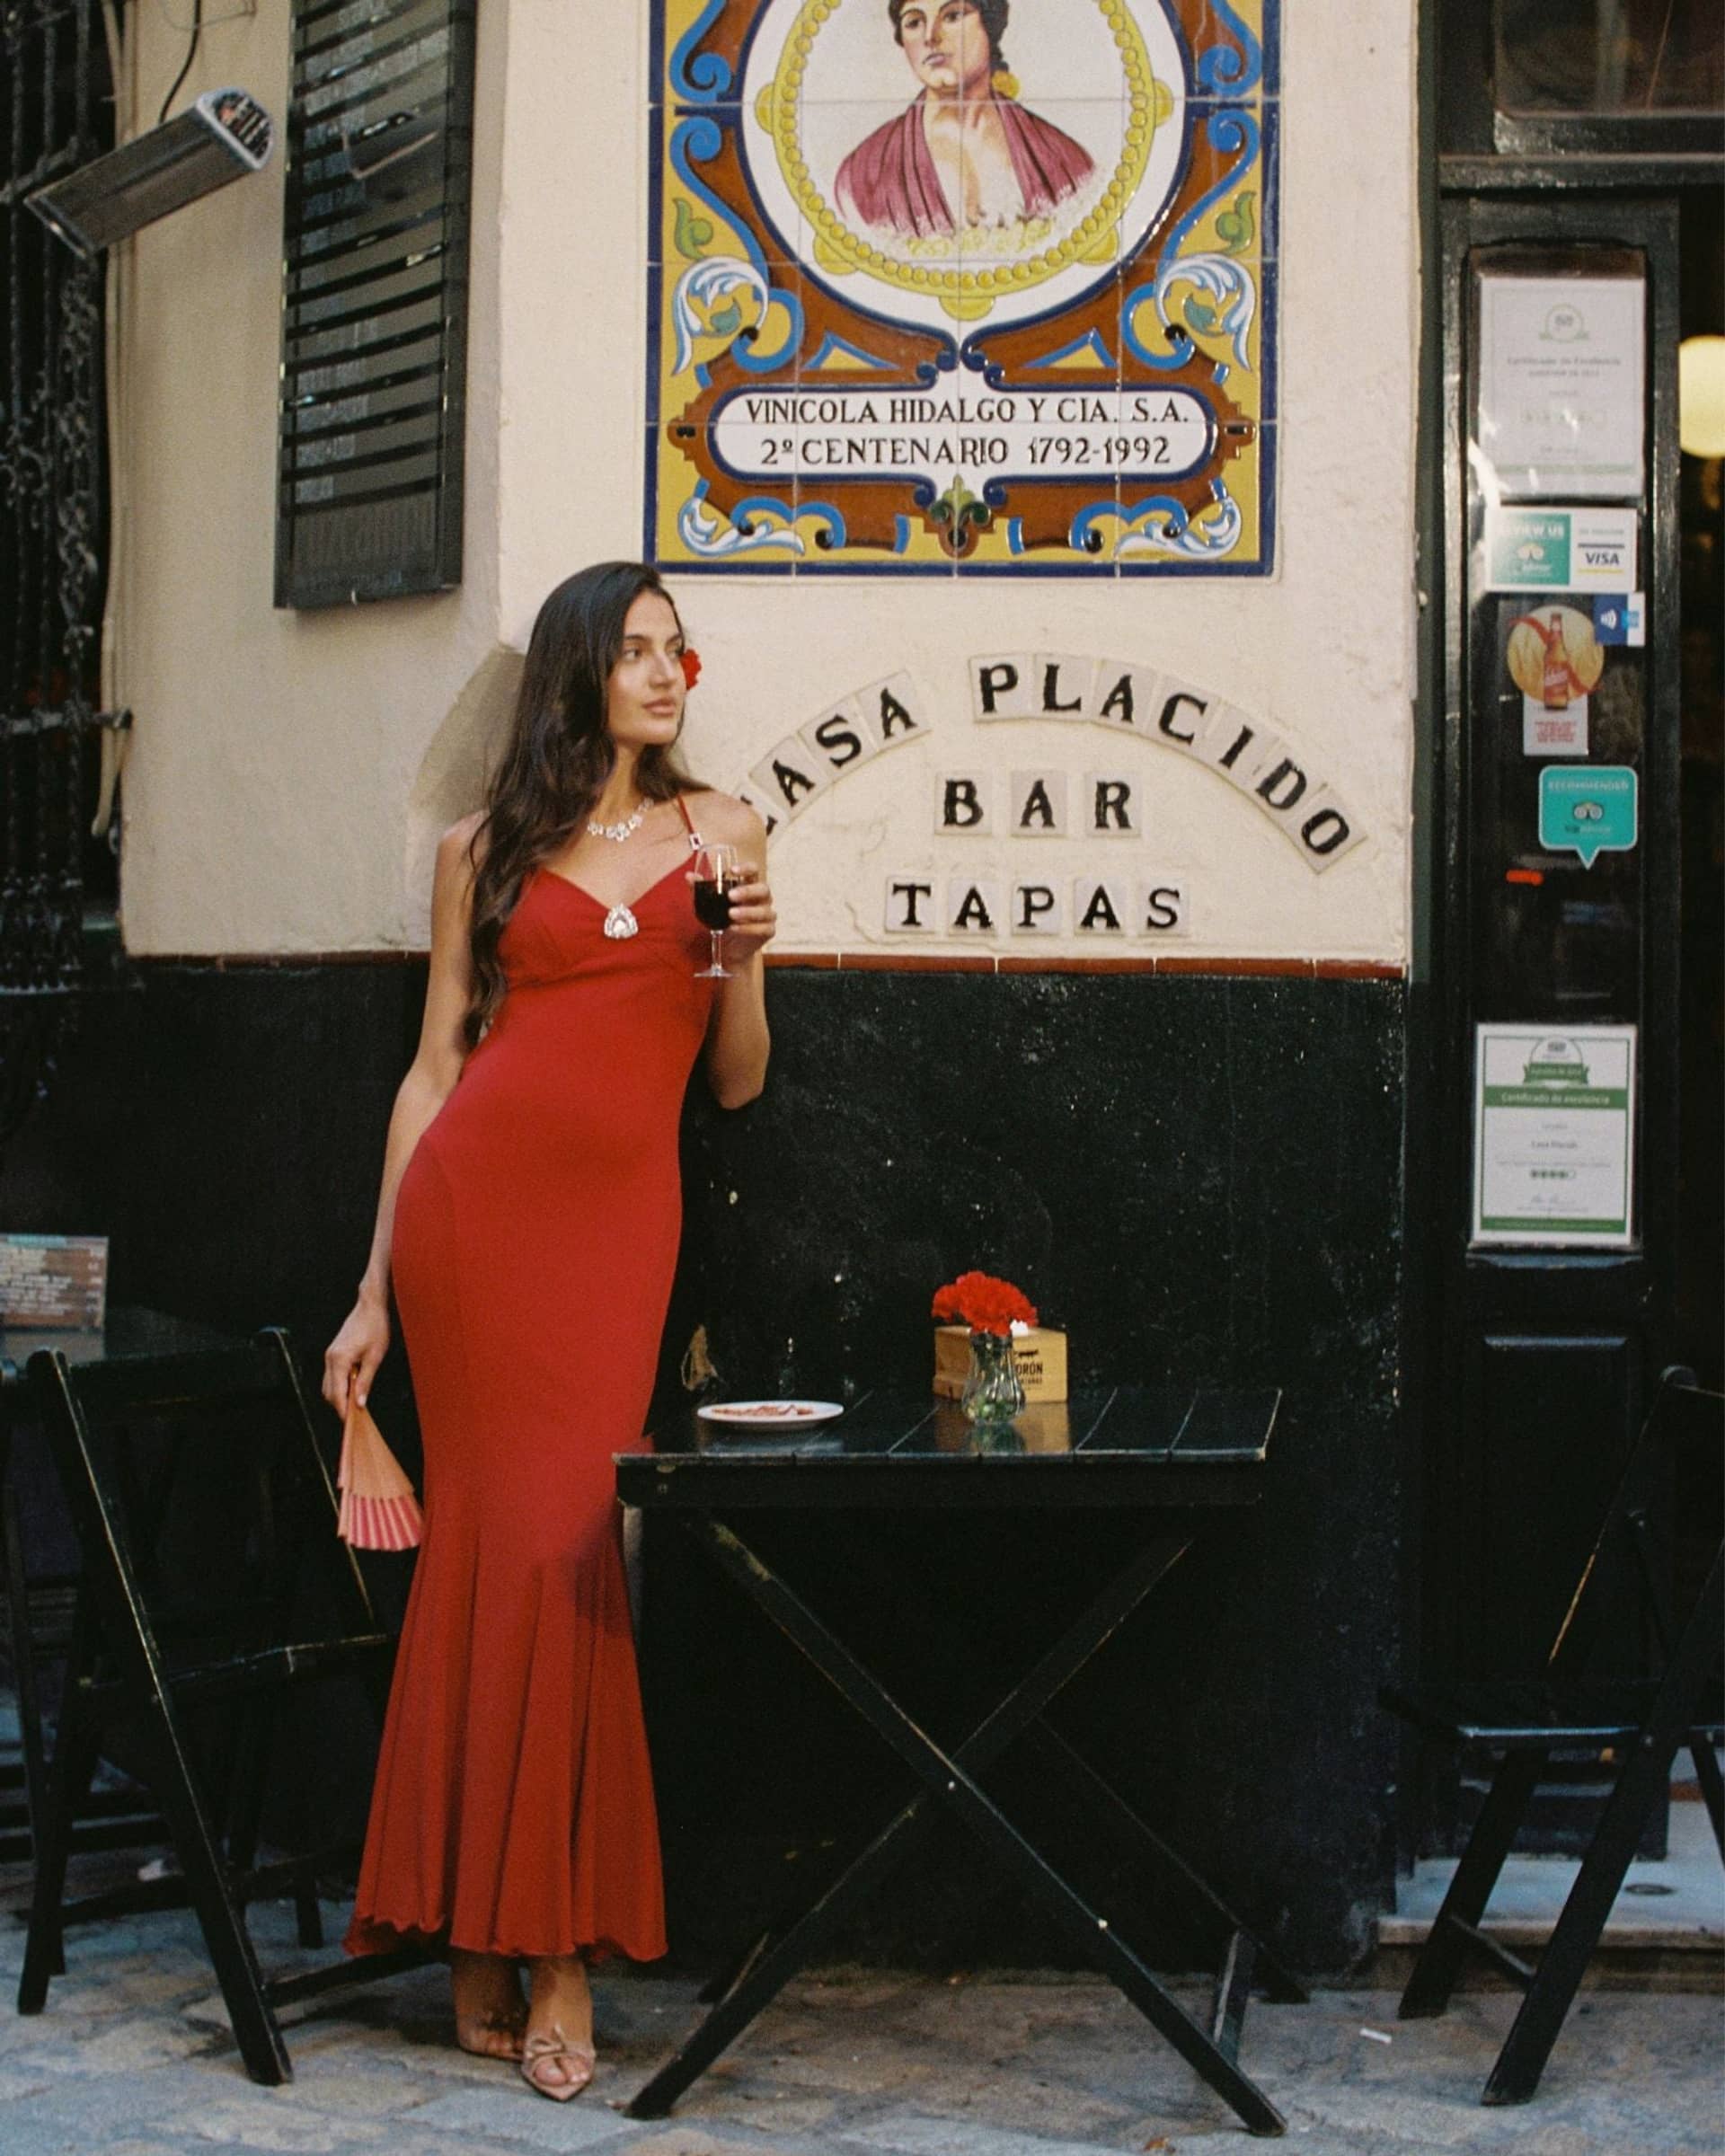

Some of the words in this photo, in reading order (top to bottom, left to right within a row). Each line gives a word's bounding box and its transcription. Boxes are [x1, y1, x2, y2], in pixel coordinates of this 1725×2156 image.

[746, 398, 880, 424] VINICOLA
[889, 398, 1016, 424] HIDALGO
[1027, 397, 1046, 424] Y
[1057, 397, 1119, 424] CIA.
[1131, 397, 1189, 424] S.A.
[801, 437, 1009, 468] CENTENARIO
[1028, 436, 1172, 465] 1792-1992
[1585, 552, 1621, 565] VISA
[739, 687, 917, 837] ASA
[978, 663, 1351, 857] PLACIDO
[942, 779, 1132, 829] BAR
[891, 884, 1181, 932] TAPAS
